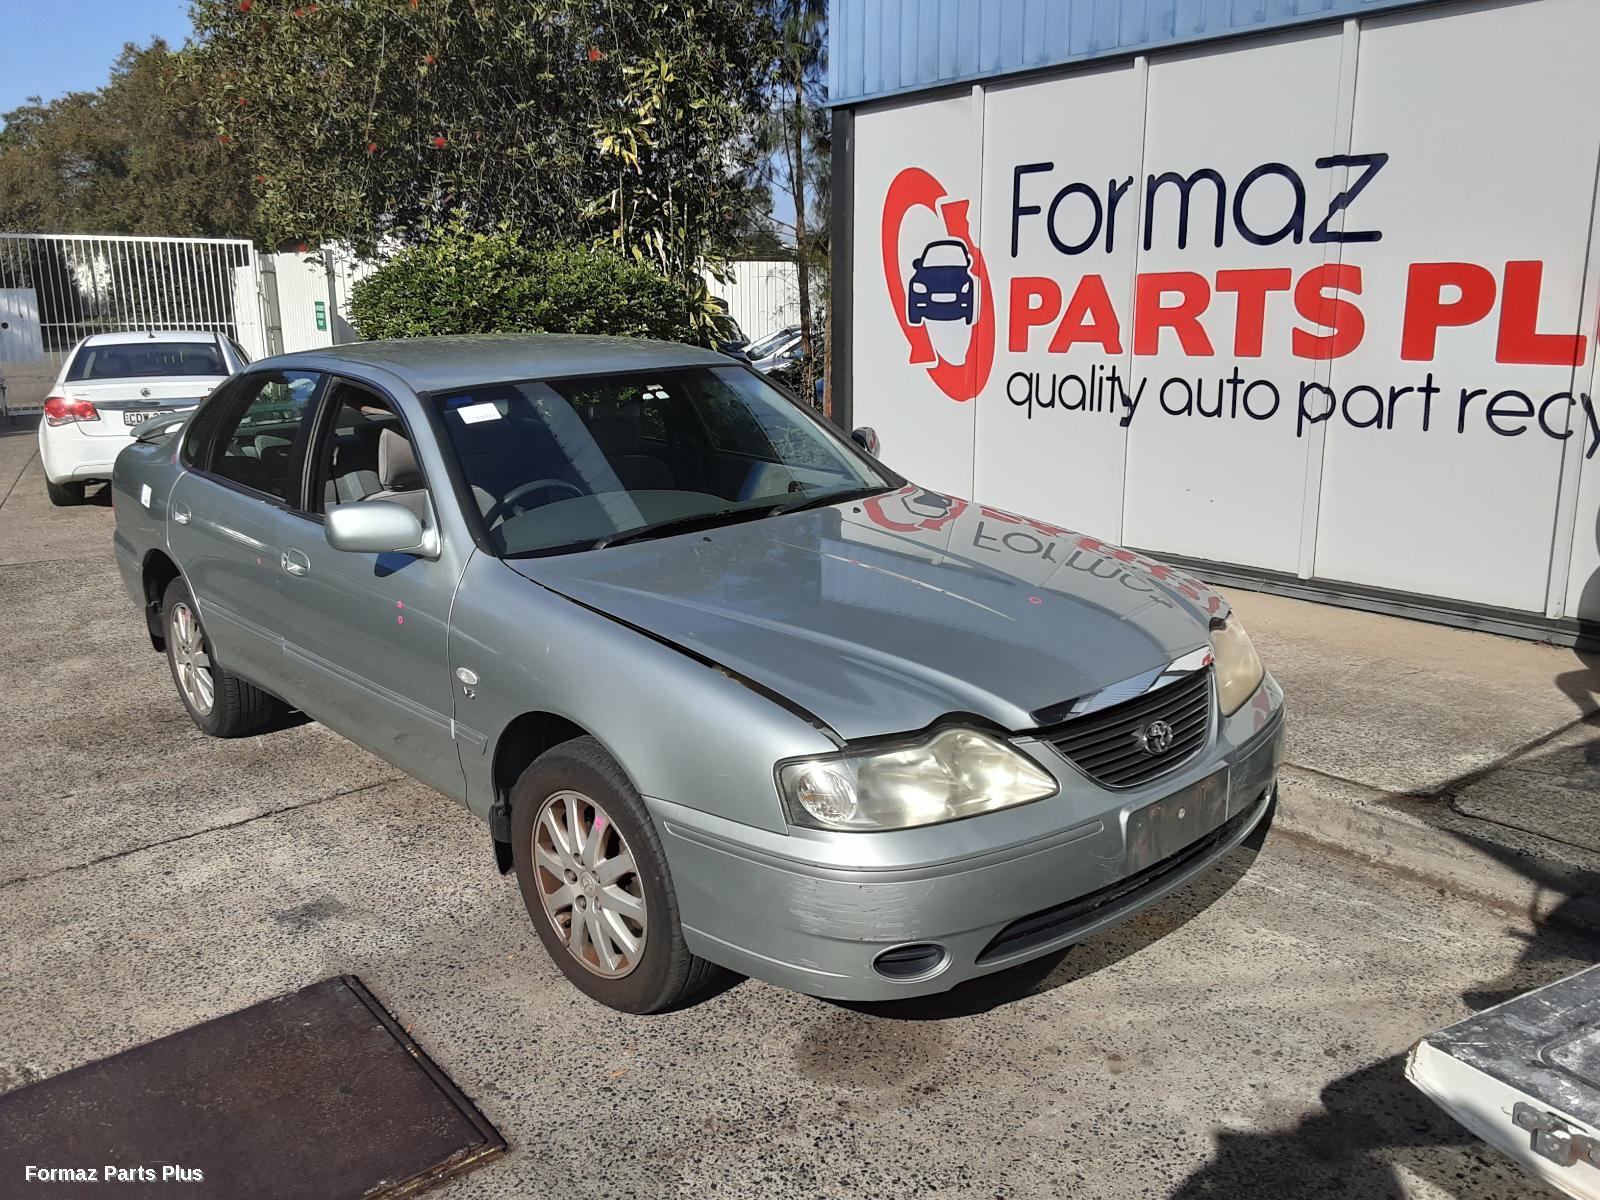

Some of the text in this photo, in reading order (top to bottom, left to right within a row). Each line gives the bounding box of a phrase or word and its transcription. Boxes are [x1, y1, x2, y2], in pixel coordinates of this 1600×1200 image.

[1011, 153, 1388, 257] Formaz
[1009, 261, 1600, 366] PARTS PL
[1007, 365, 1147, 427] quality
[1160, 367, 1279, 420] auto
[1297, 373, 1440, 437] part
